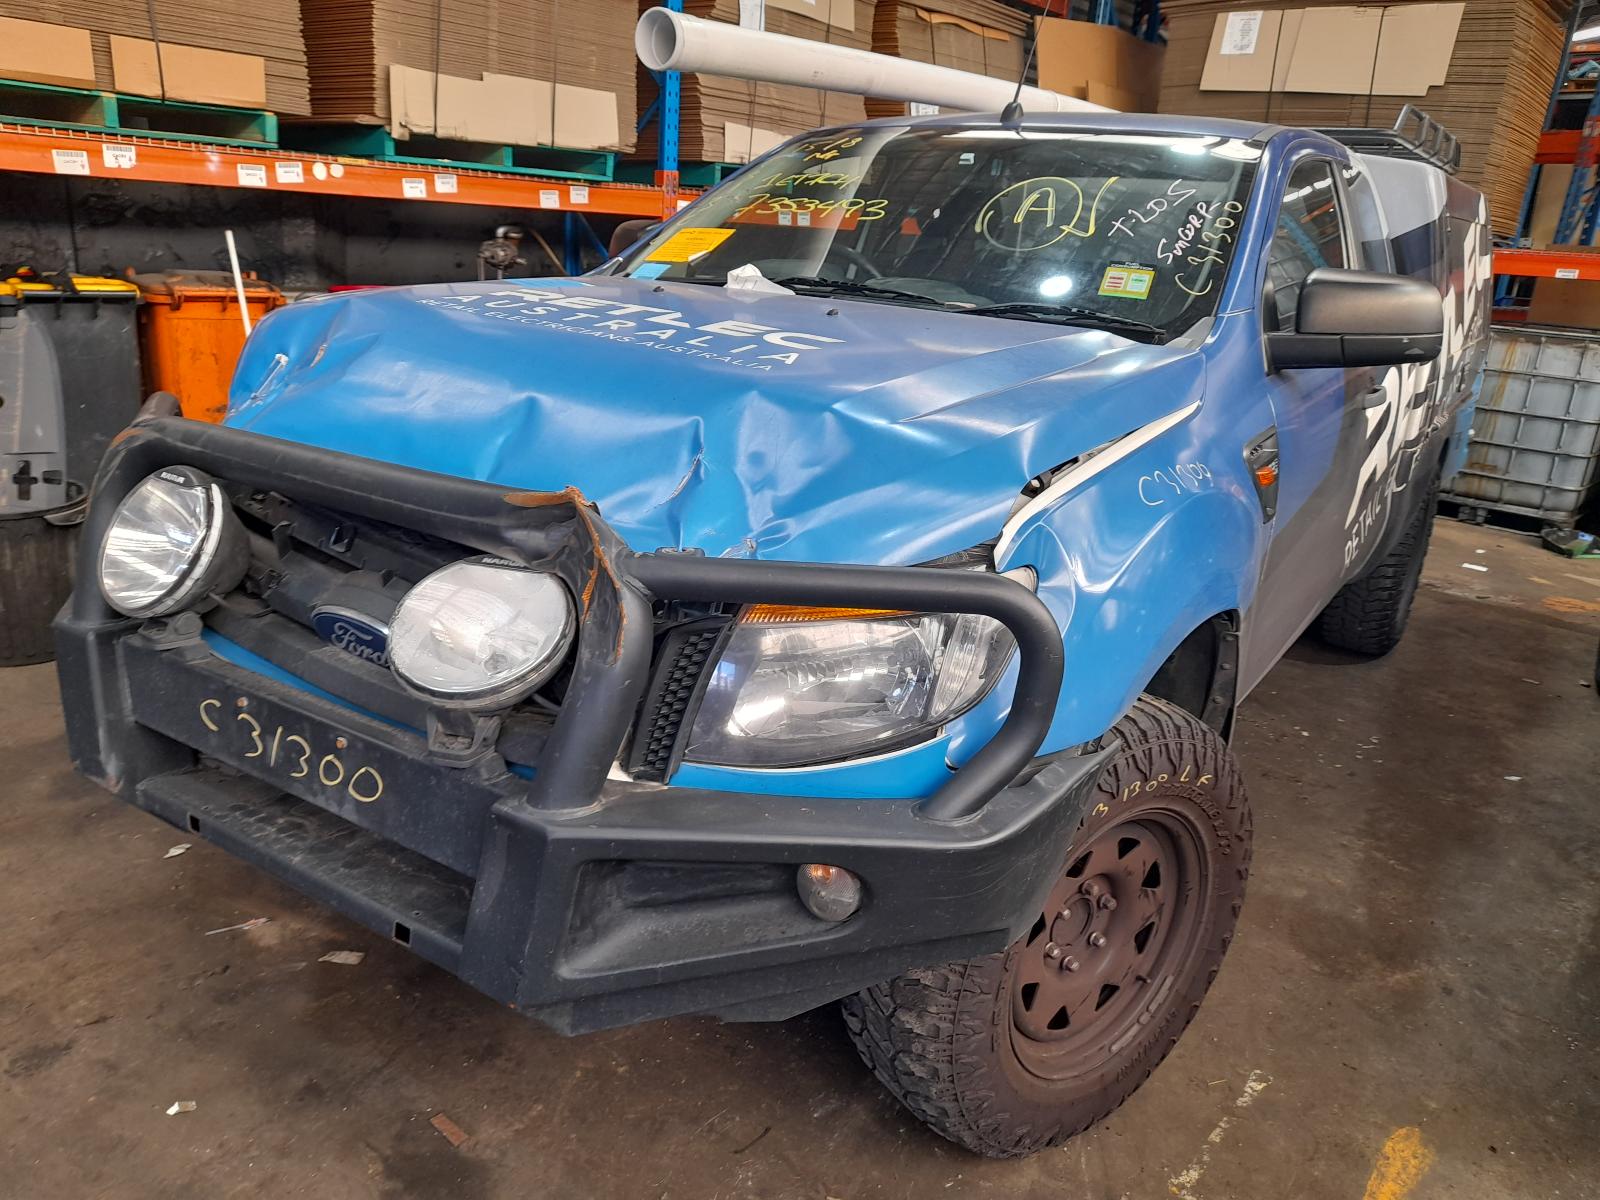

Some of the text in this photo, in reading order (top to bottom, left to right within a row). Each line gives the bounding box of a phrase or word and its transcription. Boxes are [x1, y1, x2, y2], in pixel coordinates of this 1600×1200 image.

[1013, 187, 1056, 228] A
[442, 294, 800, 365] AUSTRALIA
[482, 311, 636, 343] ELECTRICIANS
[636, 340, 774, 372] AUSTRALIA
[488, 288, 847, 350] RETLEC
[330, 621, 391, 669] Ford
